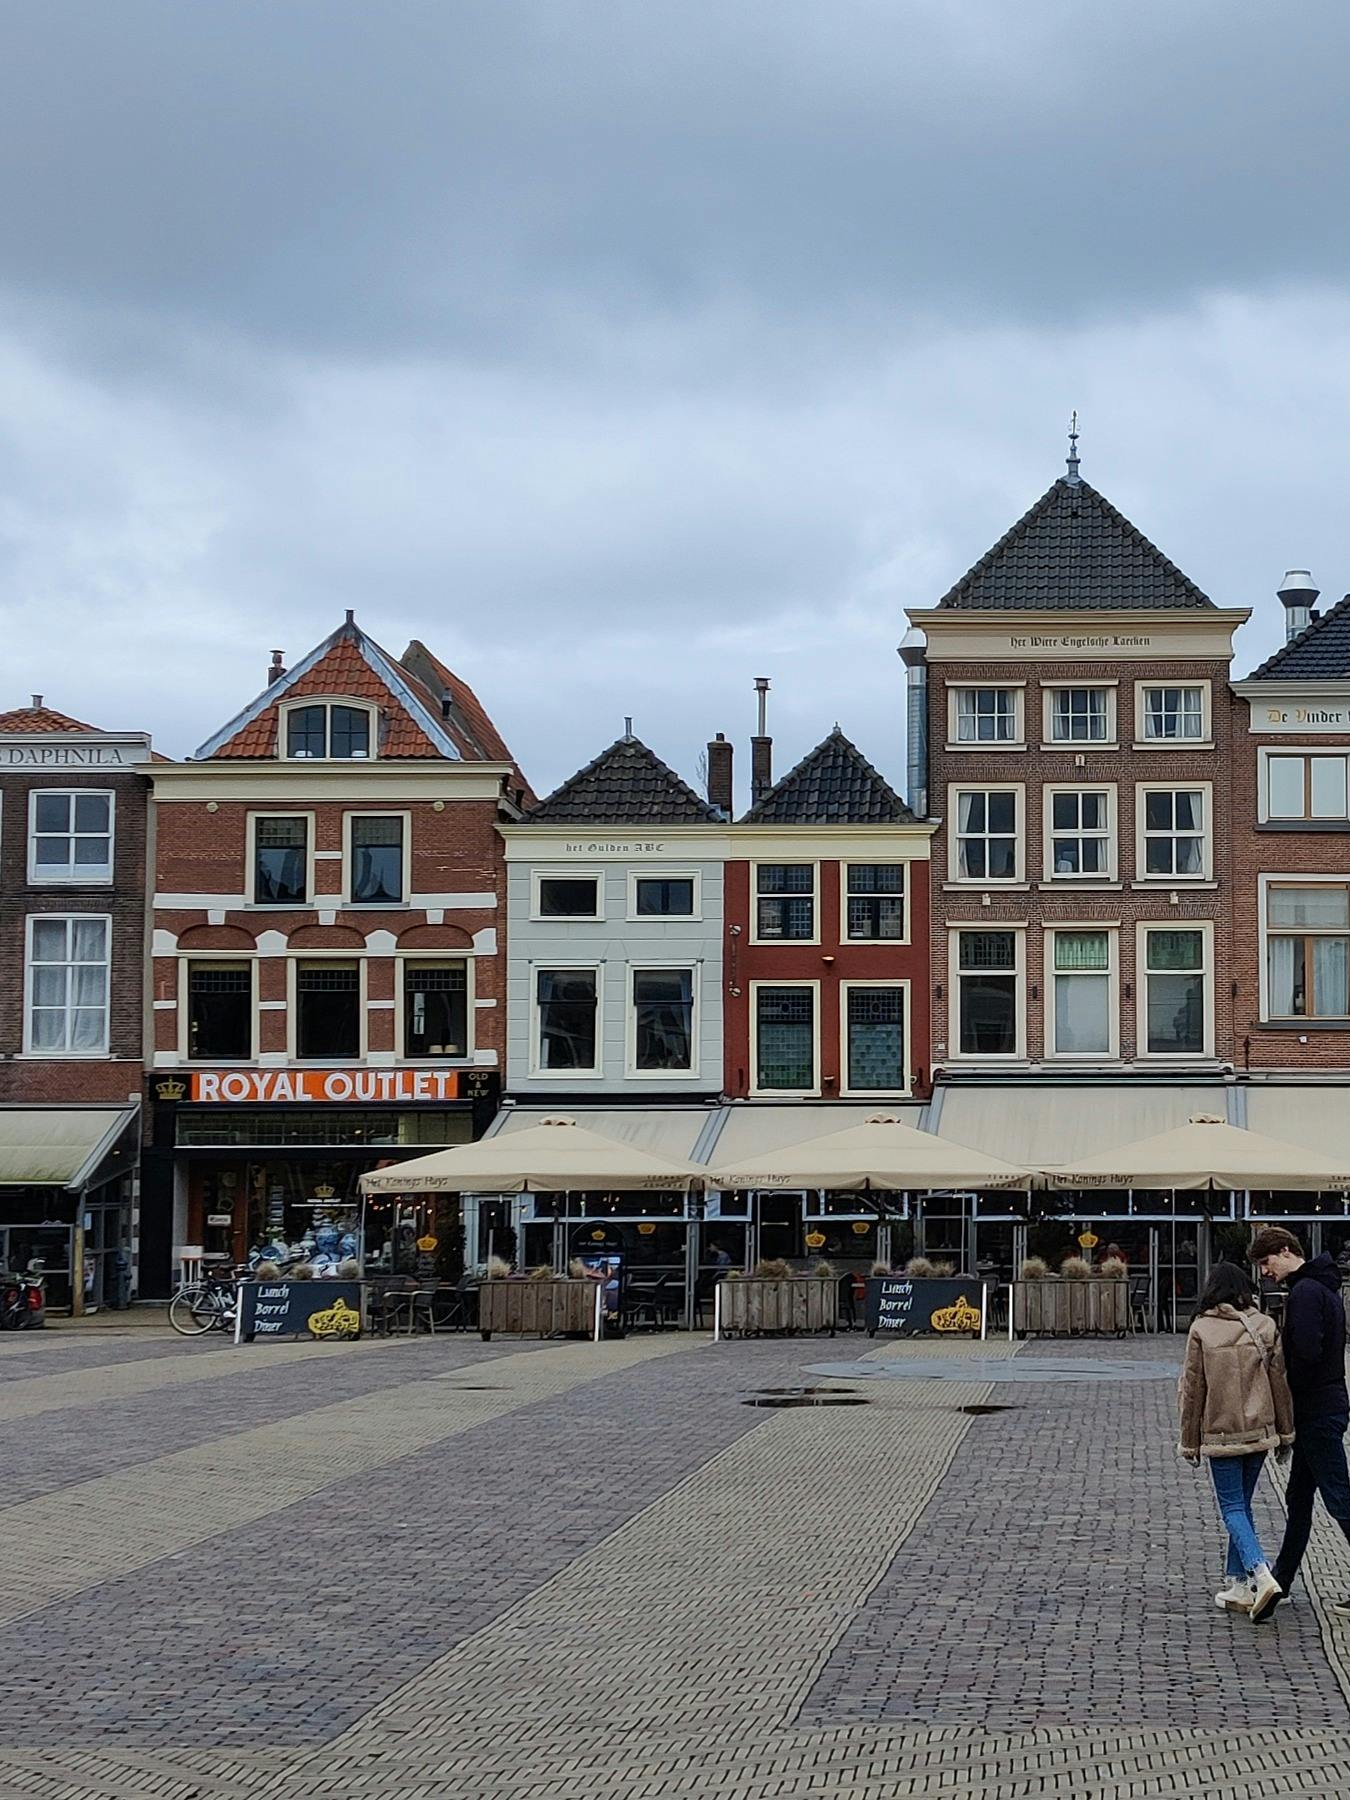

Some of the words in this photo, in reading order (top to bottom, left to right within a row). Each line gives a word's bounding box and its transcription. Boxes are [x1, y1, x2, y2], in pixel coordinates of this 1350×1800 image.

[1267, 709, 1287, 722] De
[1296, 709, 1342, 723] Vinder
[8, 749, 123, 764] DAPHNILA
[566, 843, 583, 852] het
[634, 843, 664, 852] ABC
[200, 1073, 312, 1101] ROYAL
[324, 1071, 450, 1100] OUTLET
[1110, 1174, 1134, 1186] Huys
[257, 1284, 290, 1299] Lunch
[881, 1280, 913, 1296] Lunch
[254, 1301, 290, 1315] Borrel
[879, 1297, 913, 1312] Borrel
[253, 1319, 283, 1333] Diner
[878, 1315, 907, 1329] Diner
